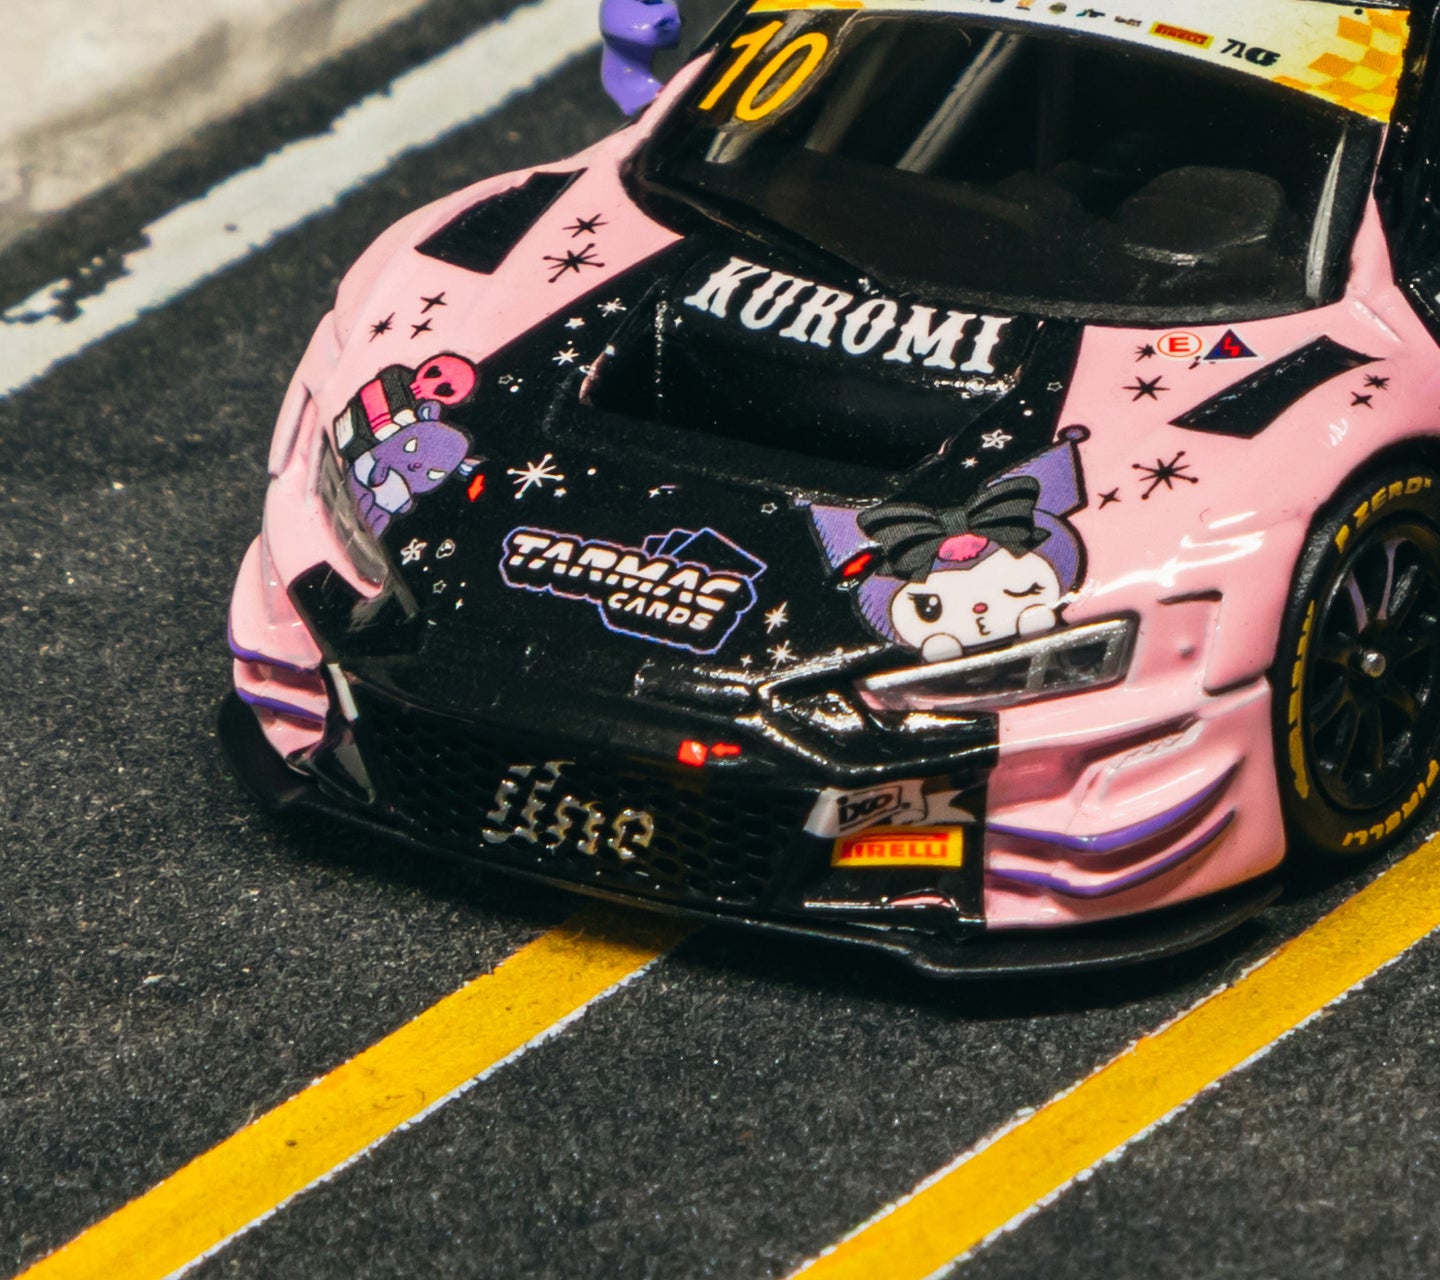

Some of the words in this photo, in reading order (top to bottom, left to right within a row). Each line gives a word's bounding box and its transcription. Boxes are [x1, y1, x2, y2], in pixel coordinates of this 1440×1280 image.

[697, 20, 829, 121] 10
[683, 256, 1013, 375] KUROMI
[509, 534, 741, 612] TARMAC
[608, 592, 714, 632] CARDS
[841, 832, 949, 860] PIRELLI
